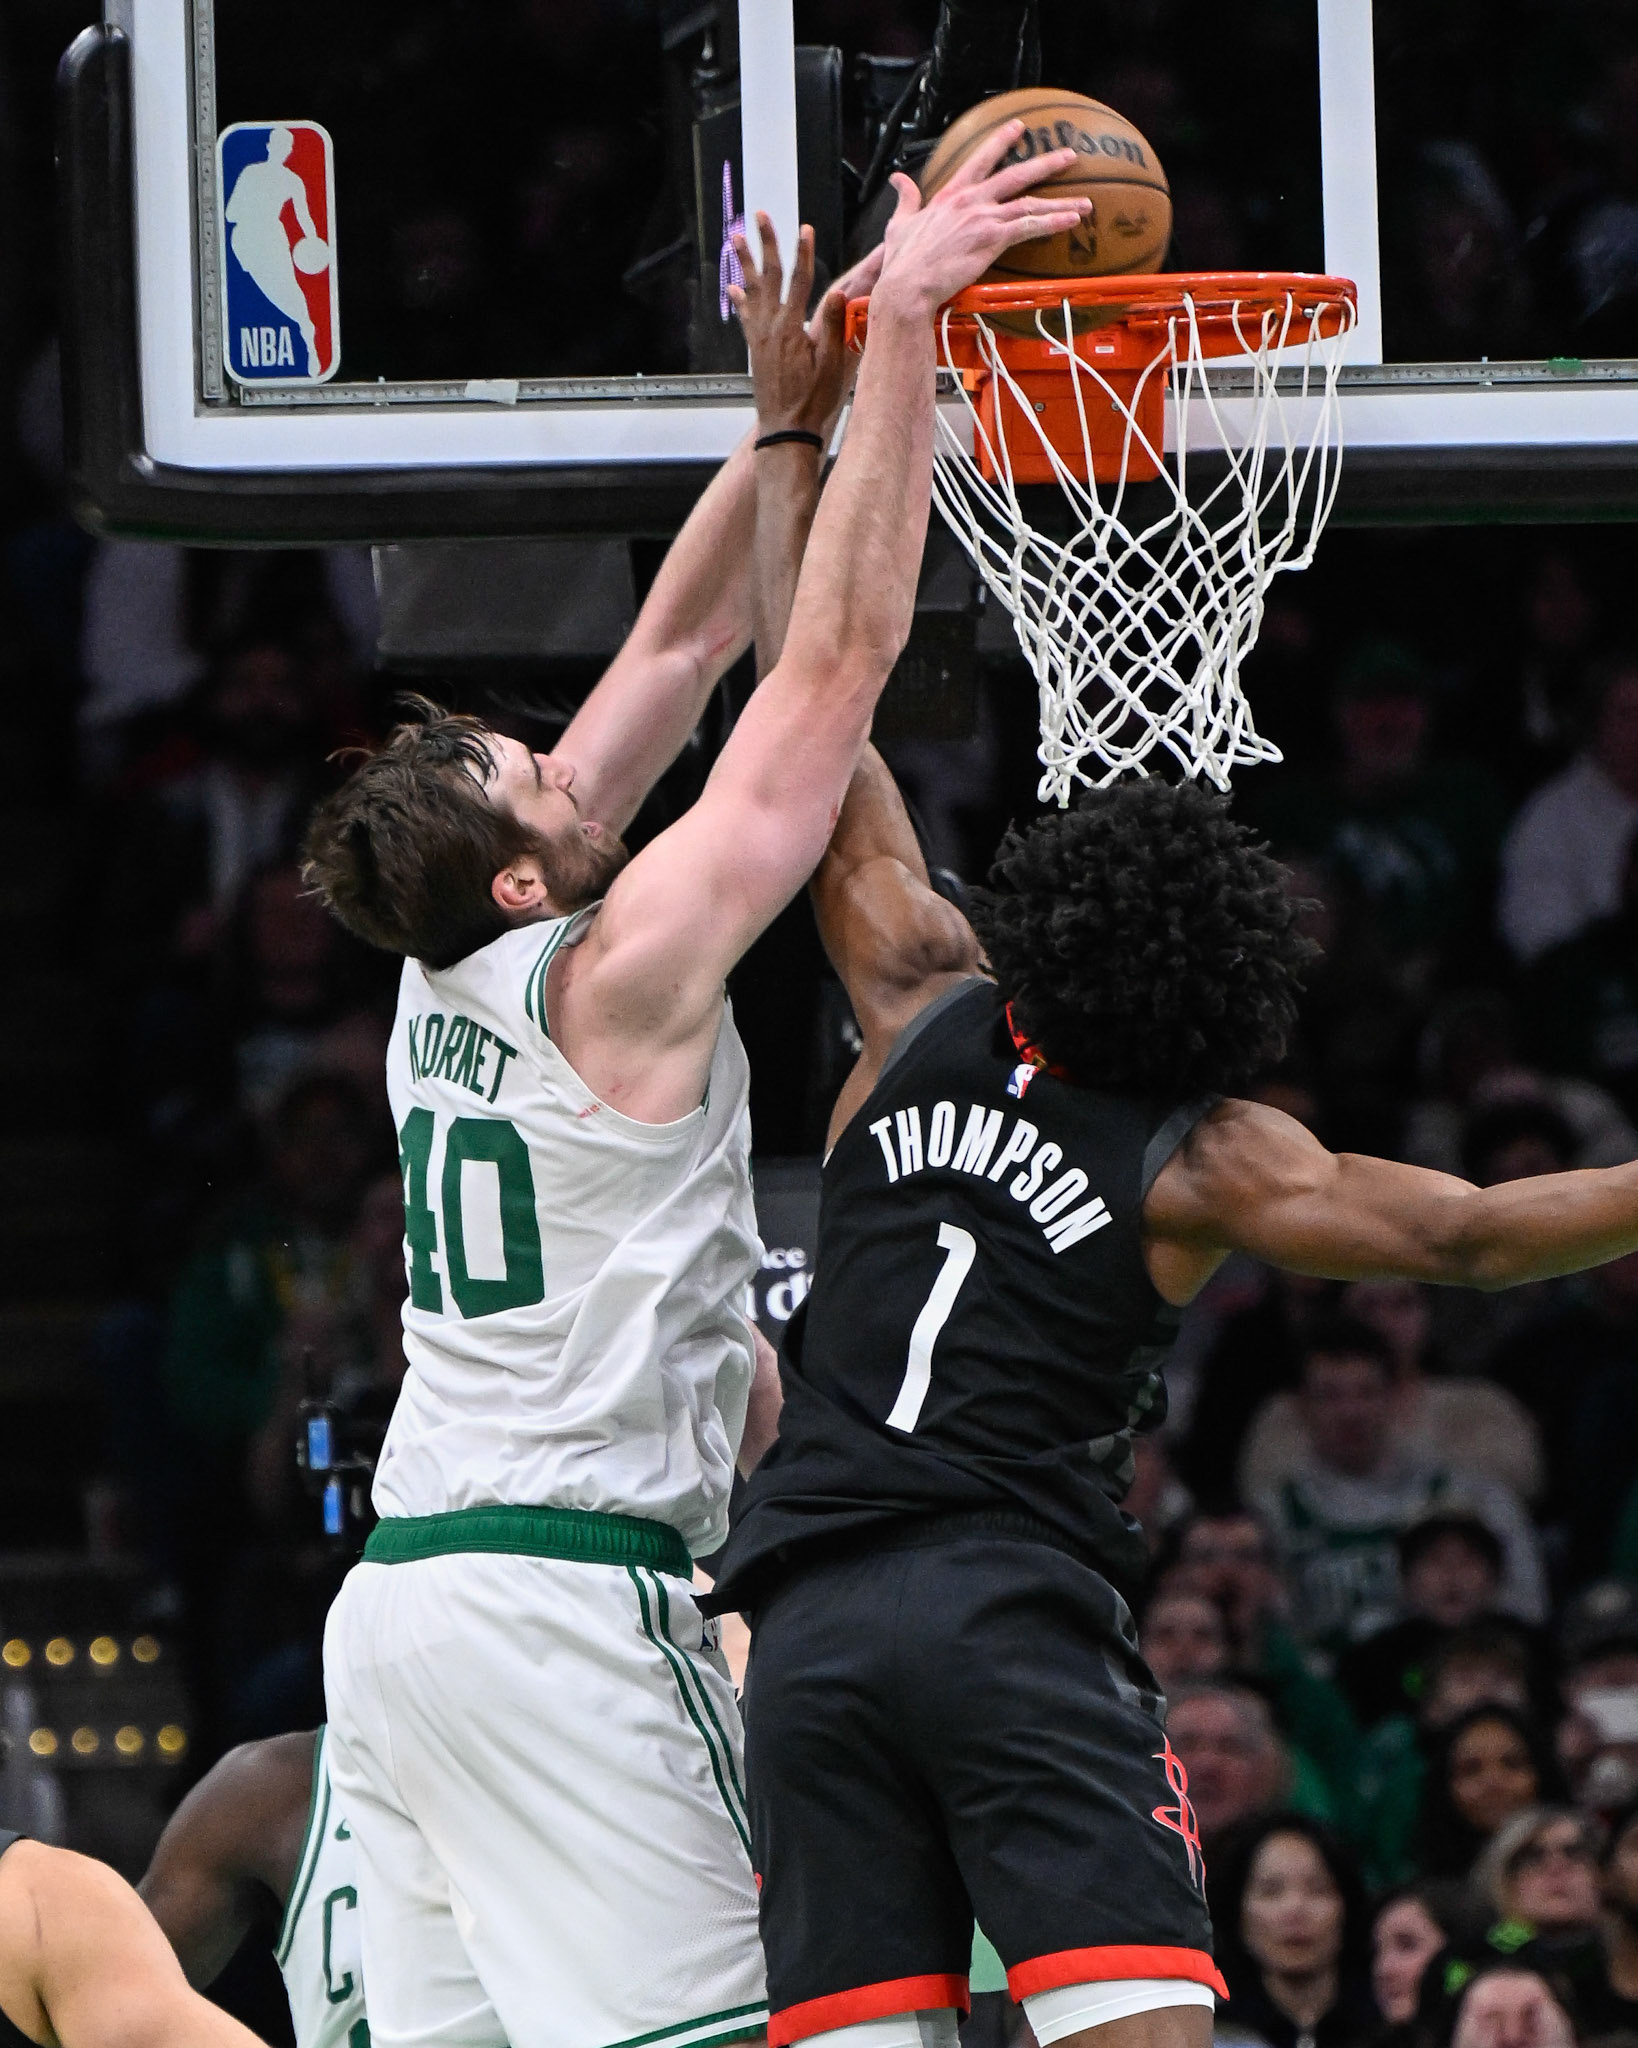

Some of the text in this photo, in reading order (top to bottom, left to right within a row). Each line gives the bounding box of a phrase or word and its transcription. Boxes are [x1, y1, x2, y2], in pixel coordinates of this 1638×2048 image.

[240, 326, 296, 368] NBA
[408, 1013, 518, 1104] KORNET
[399, 1105, 545, 1320] 40
[868, 1100, 1114, 1255] THOMPSON
[884, 1221, 977, 1434] 1
